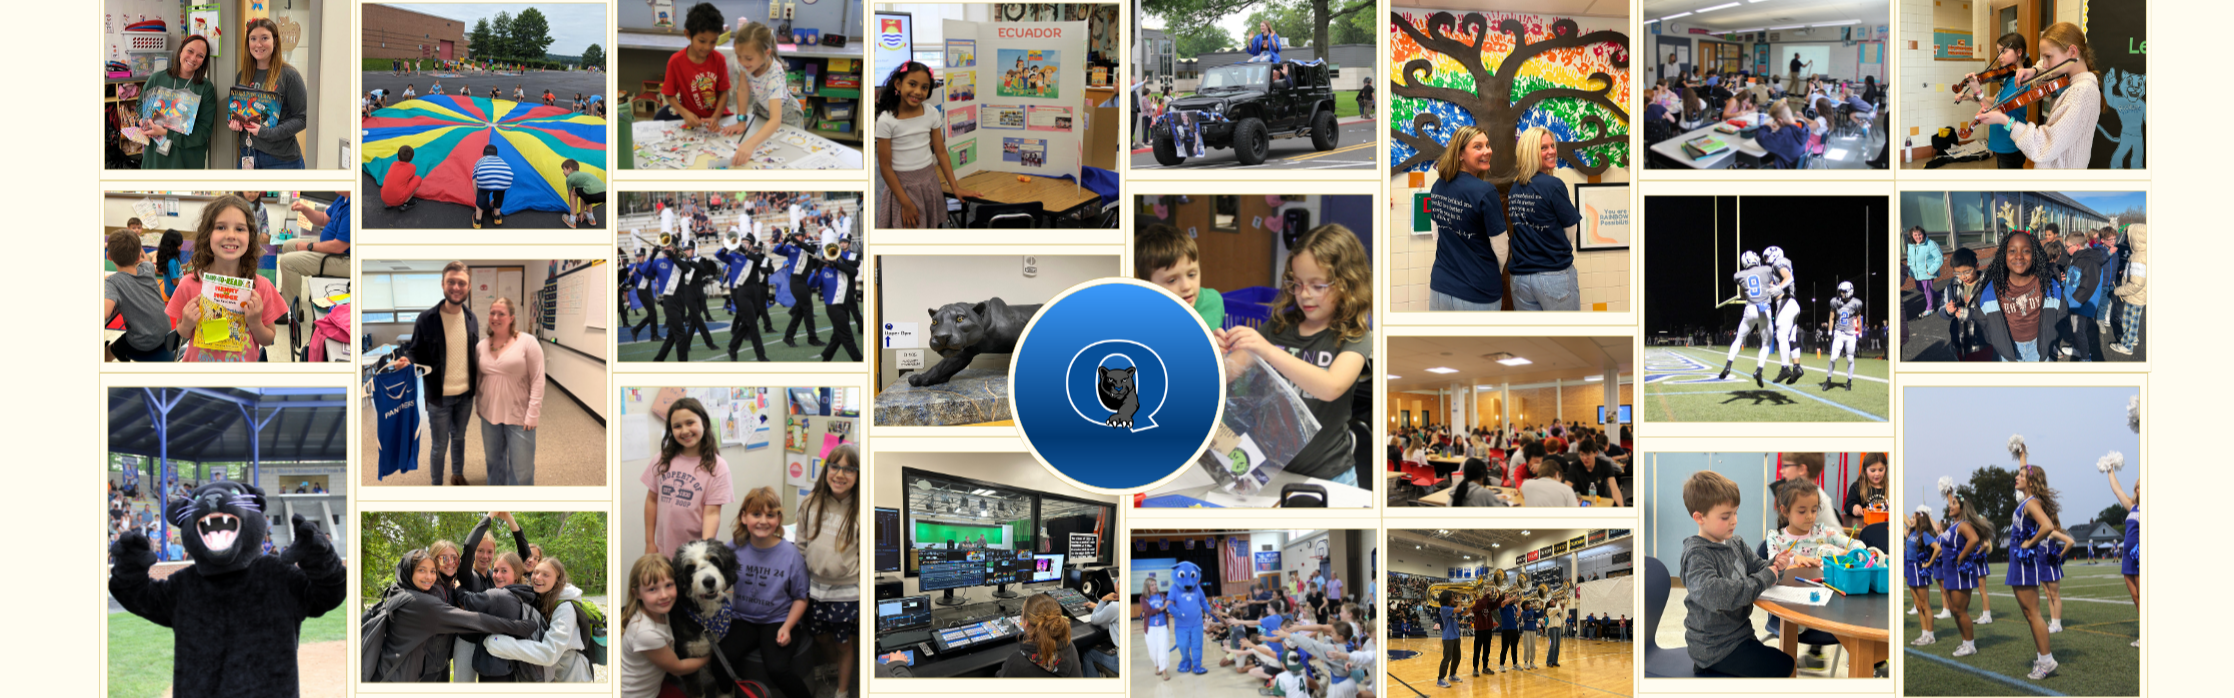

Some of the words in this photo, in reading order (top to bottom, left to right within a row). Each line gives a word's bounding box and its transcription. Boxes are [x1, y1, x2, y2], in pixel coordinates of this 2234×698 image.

[998, 27, 1062, 39] ECUADOR
[695, 72, 705, 80] ON
[1748, 275, 1761, 297] 9
[1841, 311, 1849, 325] 2
[693, 482, 703, 492] OF
[746, 565, 771, 576] MATH
[773, 569, 785, 578] 24
[1299, 677, 1306, 693] 4
